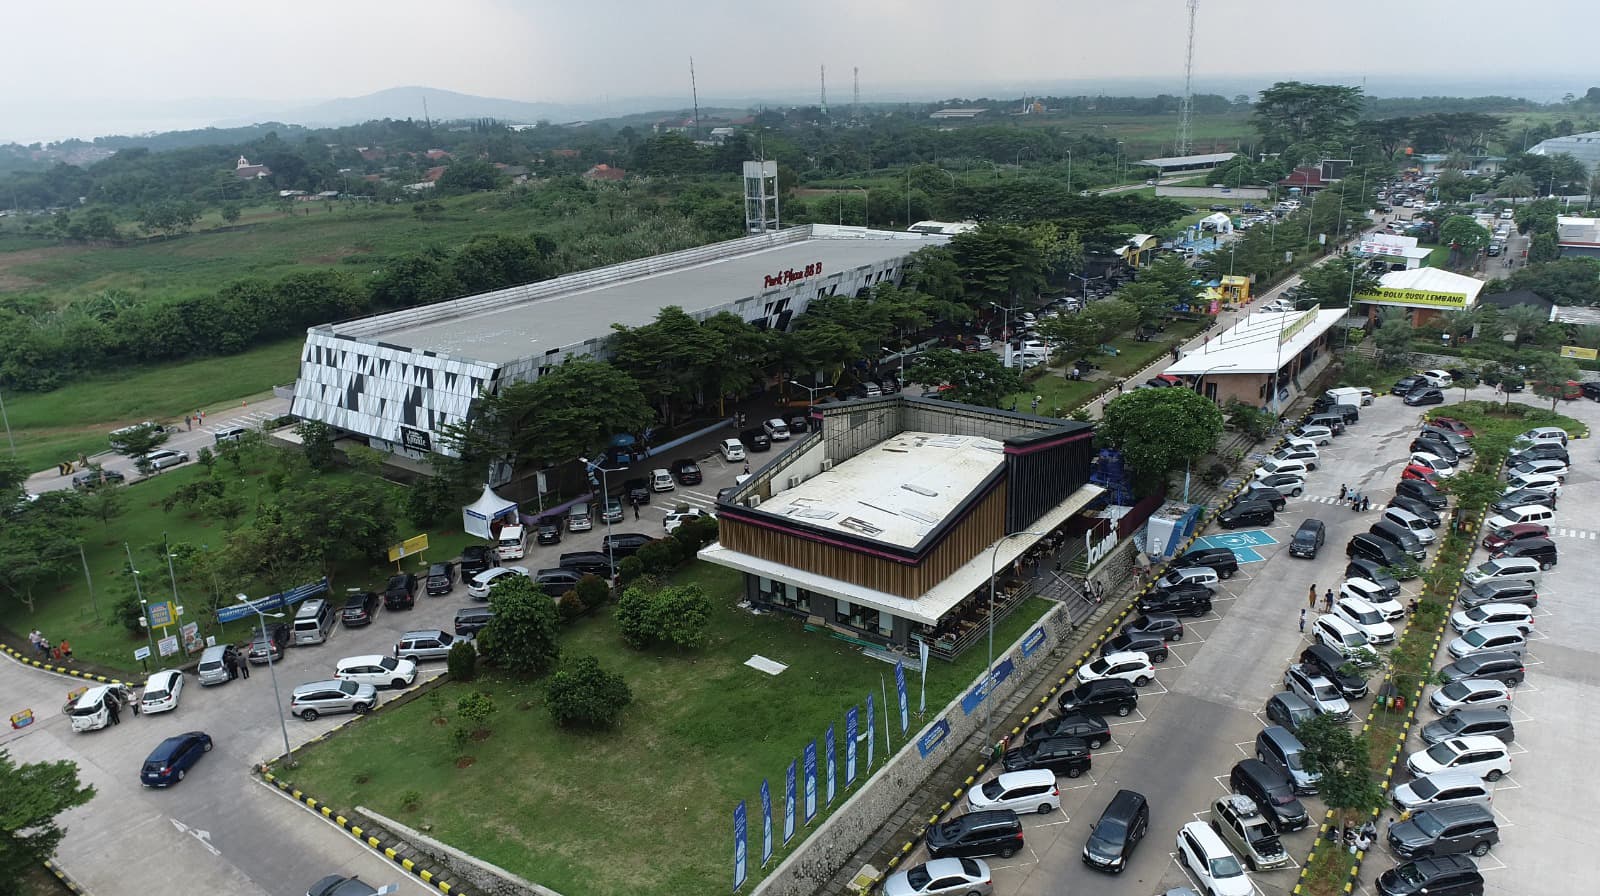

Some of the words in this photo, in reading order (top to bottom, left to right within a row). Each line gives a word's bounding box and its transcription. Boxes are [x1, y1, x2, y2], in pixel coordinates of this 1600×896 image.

[764, 271, 783, 288] Park
[784, 268, 803, 284] Plaza
[804, 263, 815, 278] 88
[815, 262, 823, 275] B
[1384, 291, 1403, 299] BOLU
[1405, 292, 1424, 301] SUSU
[1426, 294, 1463, 303] LEMBANG
